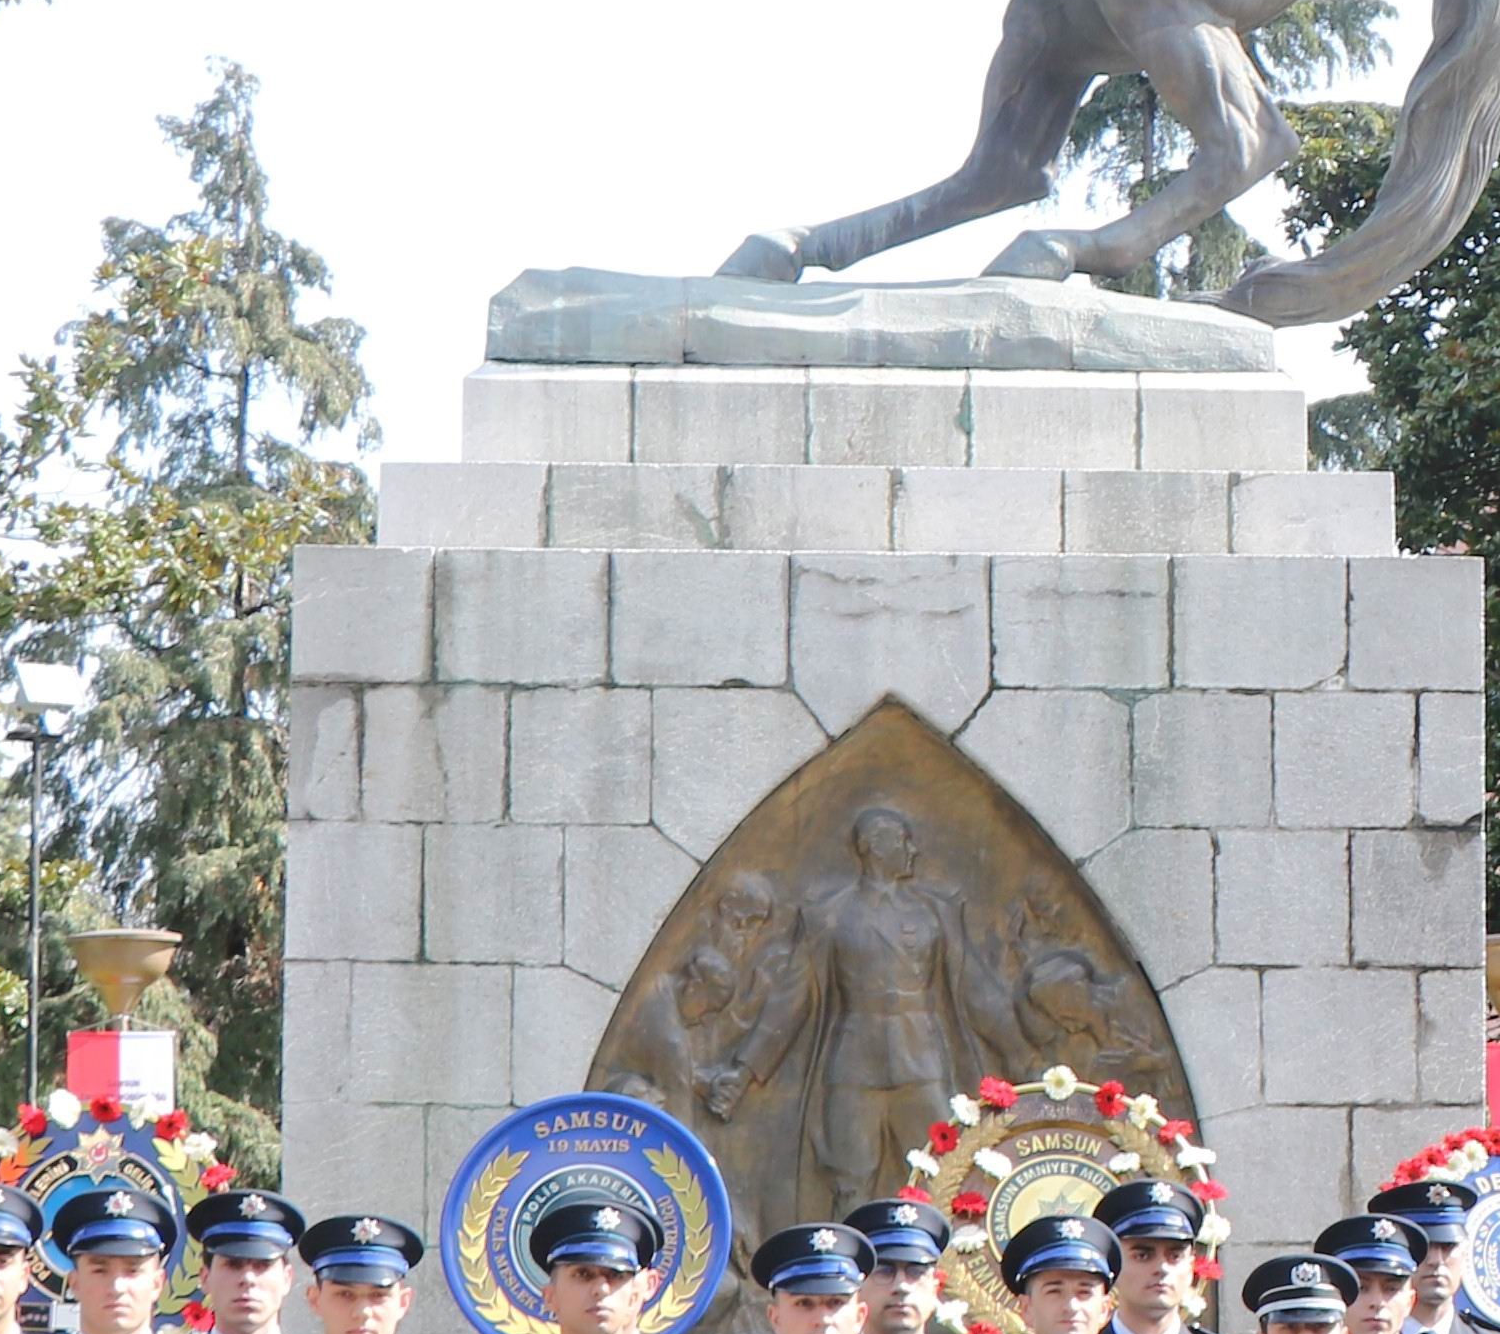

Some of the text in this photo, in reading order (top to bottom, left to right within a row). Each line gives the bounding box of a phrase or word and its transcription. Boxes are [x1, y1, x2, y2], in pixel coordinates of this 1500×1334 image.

[534, 1111, 647, 1139] SAMSUN
[548, 1139, 631, 1153] 19 MAYIS
[1016, 1133, 1102, 1157] SAMSUN
[522, 1182, 560, 1223] POLİS
[995, 1182, 1019, 1242] SAMSUN
[1016, 1161, 1079, 1187] EMNİYET
[495, 1254, 538, 1310] MESLEK
